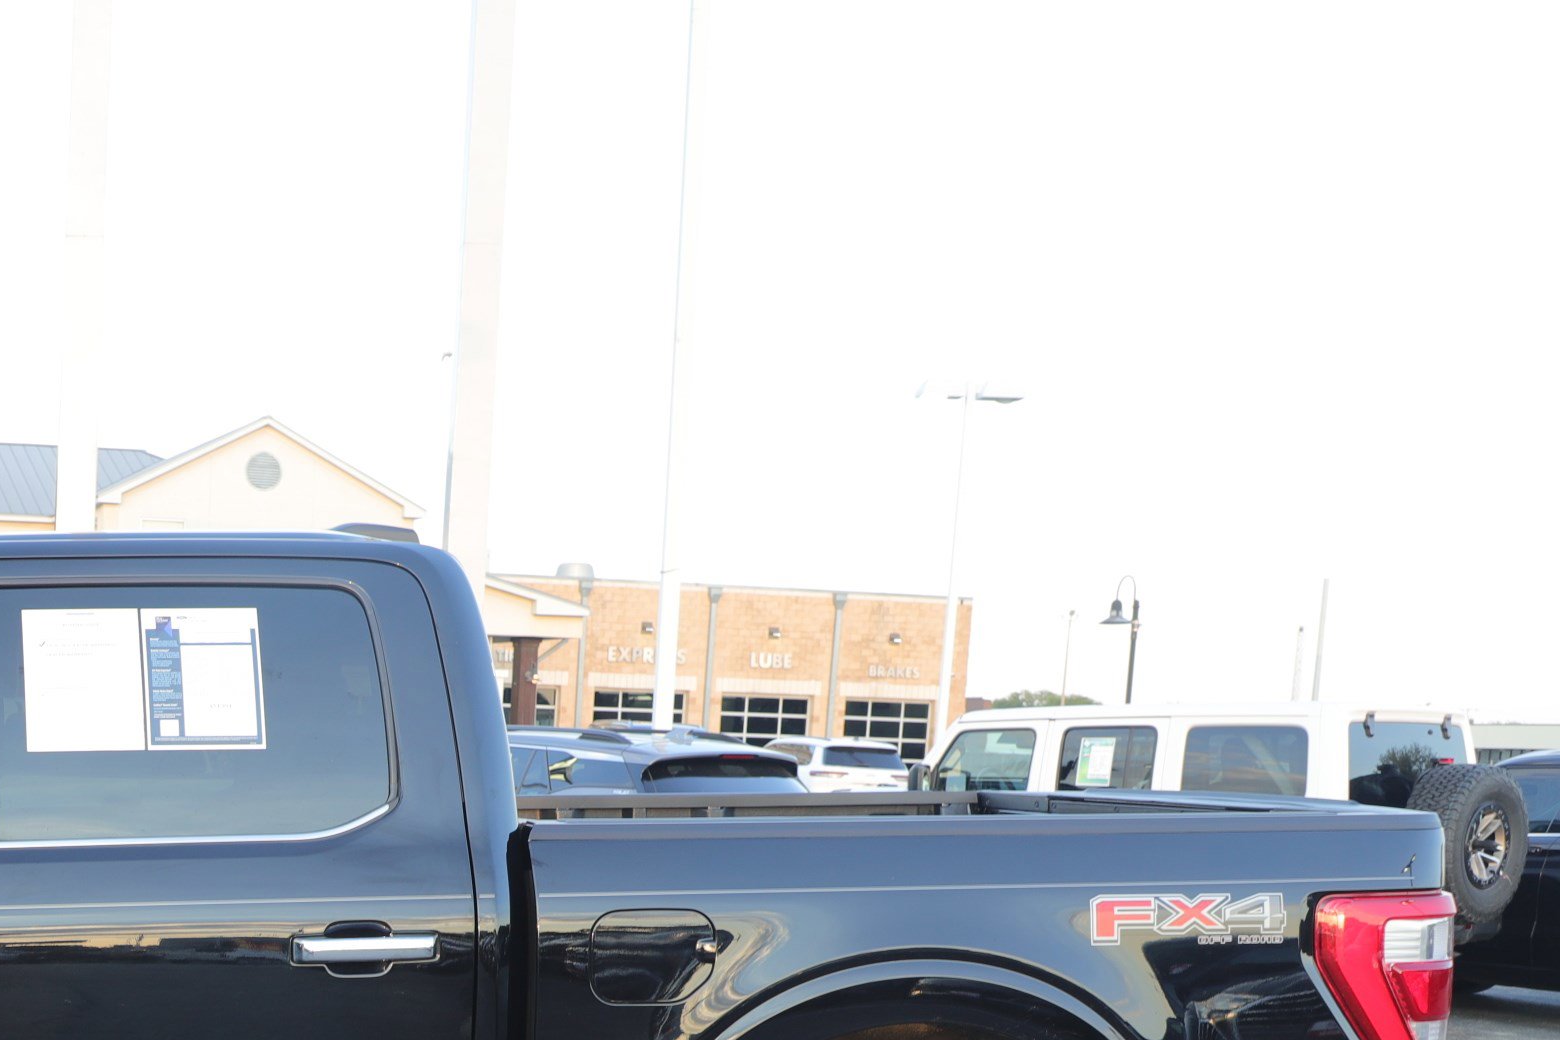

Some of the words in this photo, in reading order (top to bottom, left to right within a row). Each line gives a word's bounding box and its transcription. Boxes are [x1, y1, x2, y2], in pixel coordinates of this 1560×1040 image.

[607, 645, 688, 665] EXPRS
[750, 652, 792, 669] LUBE
[869, 664, 920, 679] BRAKES
[1091, 893, 1287, 946] FX4
[1198, 935, 1233, 945] OFF
